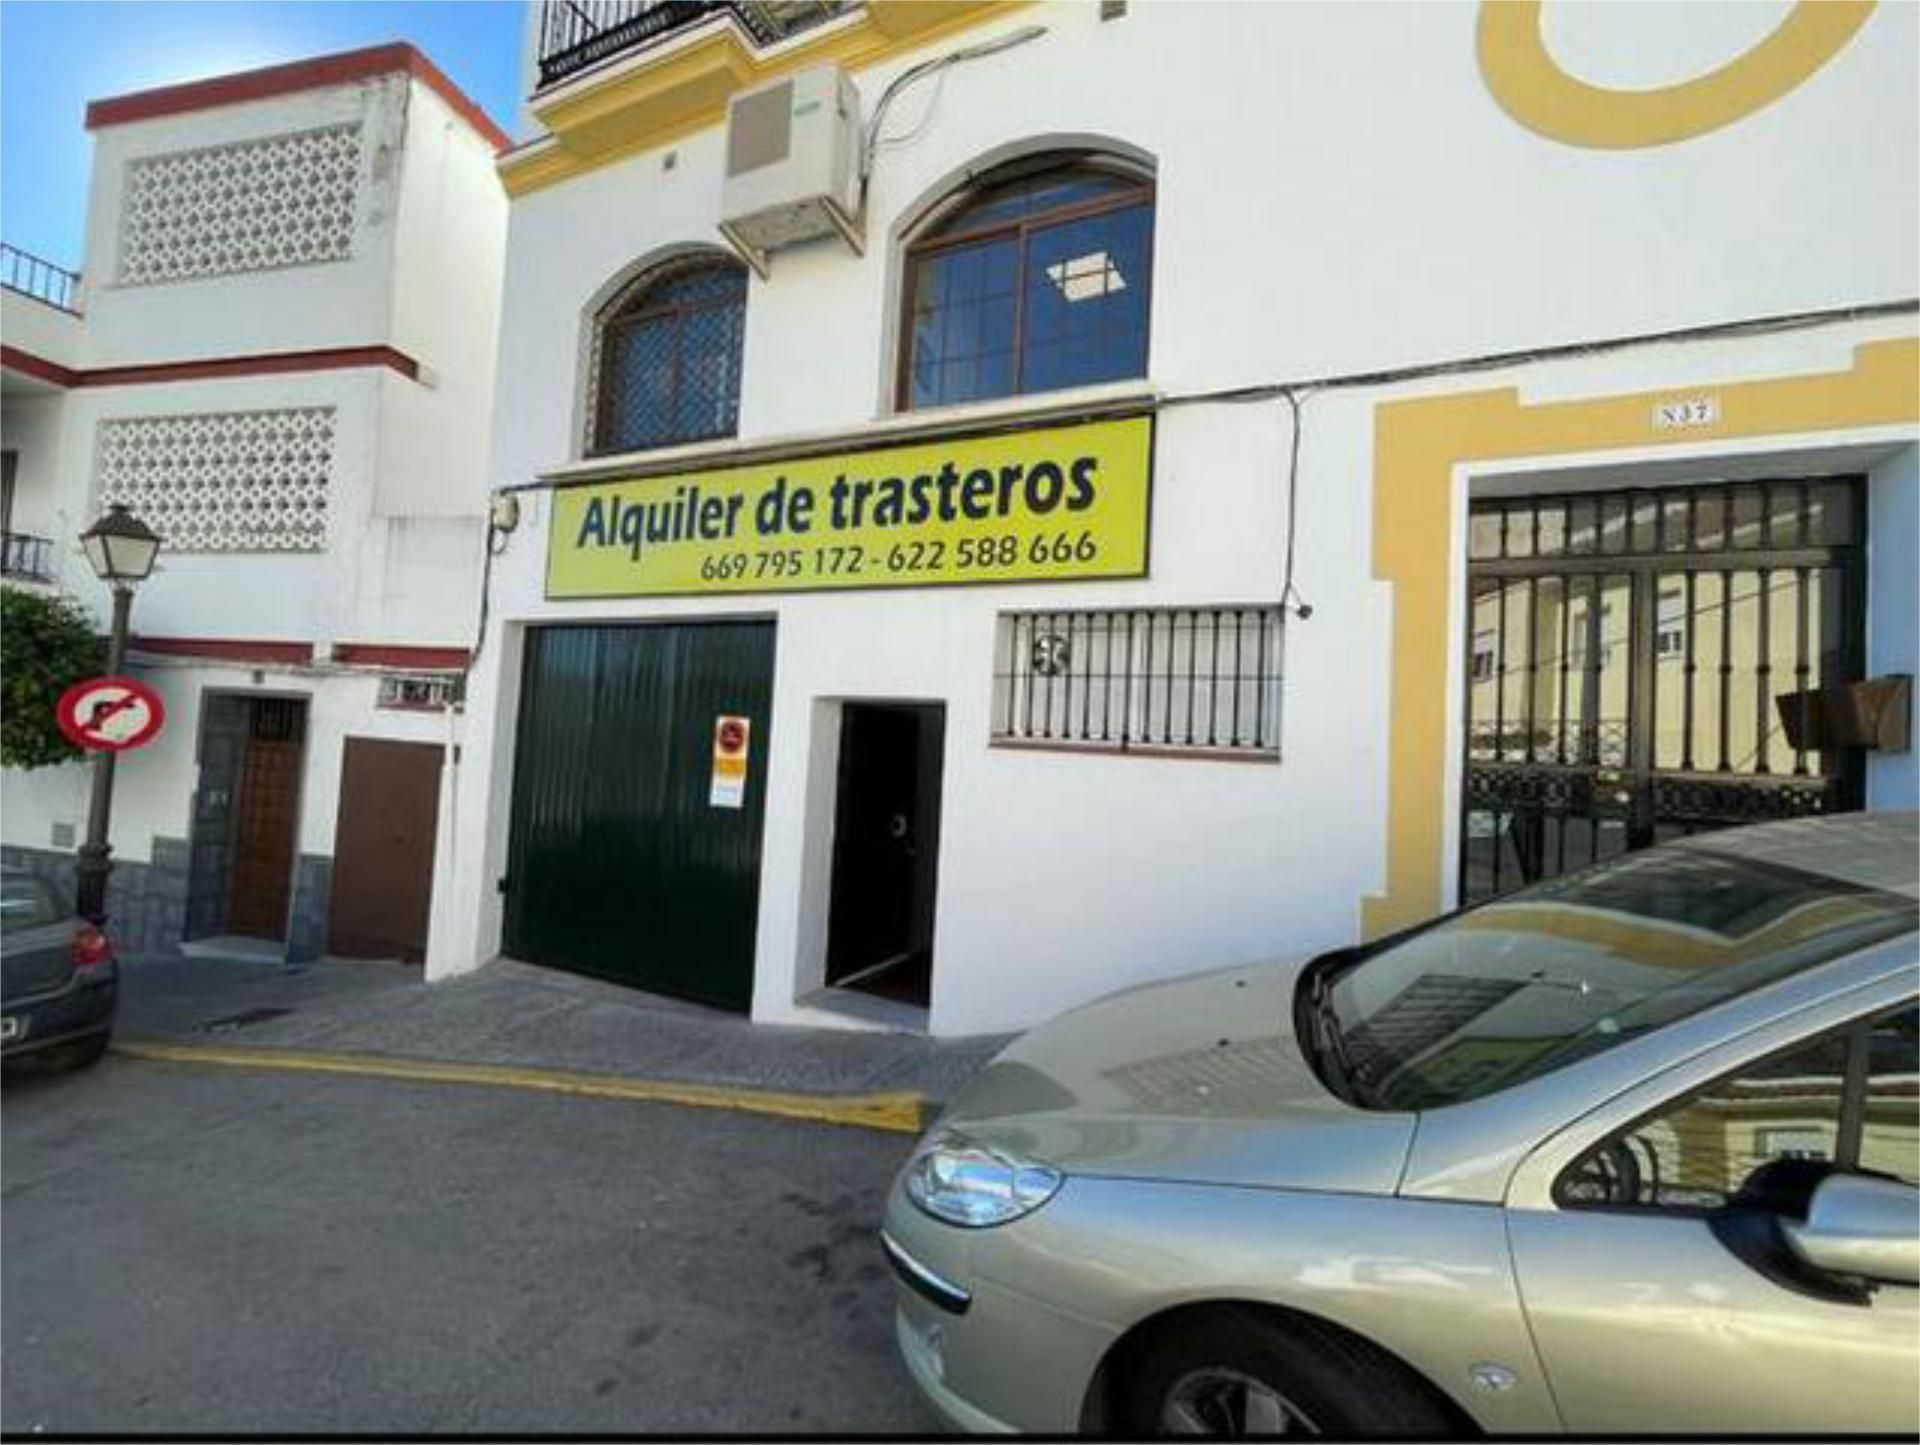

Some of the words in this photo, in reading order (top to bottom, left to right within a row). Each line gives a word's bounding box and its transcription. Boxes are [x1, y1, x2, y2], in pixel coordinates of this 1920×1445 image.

[577, 485, 744, 562] Alquiler
[755, 475, 814, 535] de
[829, 456, 1097, 530] trasteros
[701, 552, 748, 582] 669
[754, 550, 802, 578] 795
[814, 546, 864, 574] 172
[887, 541, 946, 572] 622
[956, 535, 1018, 569] 588
[1028, 530, 1097, 564] 666
